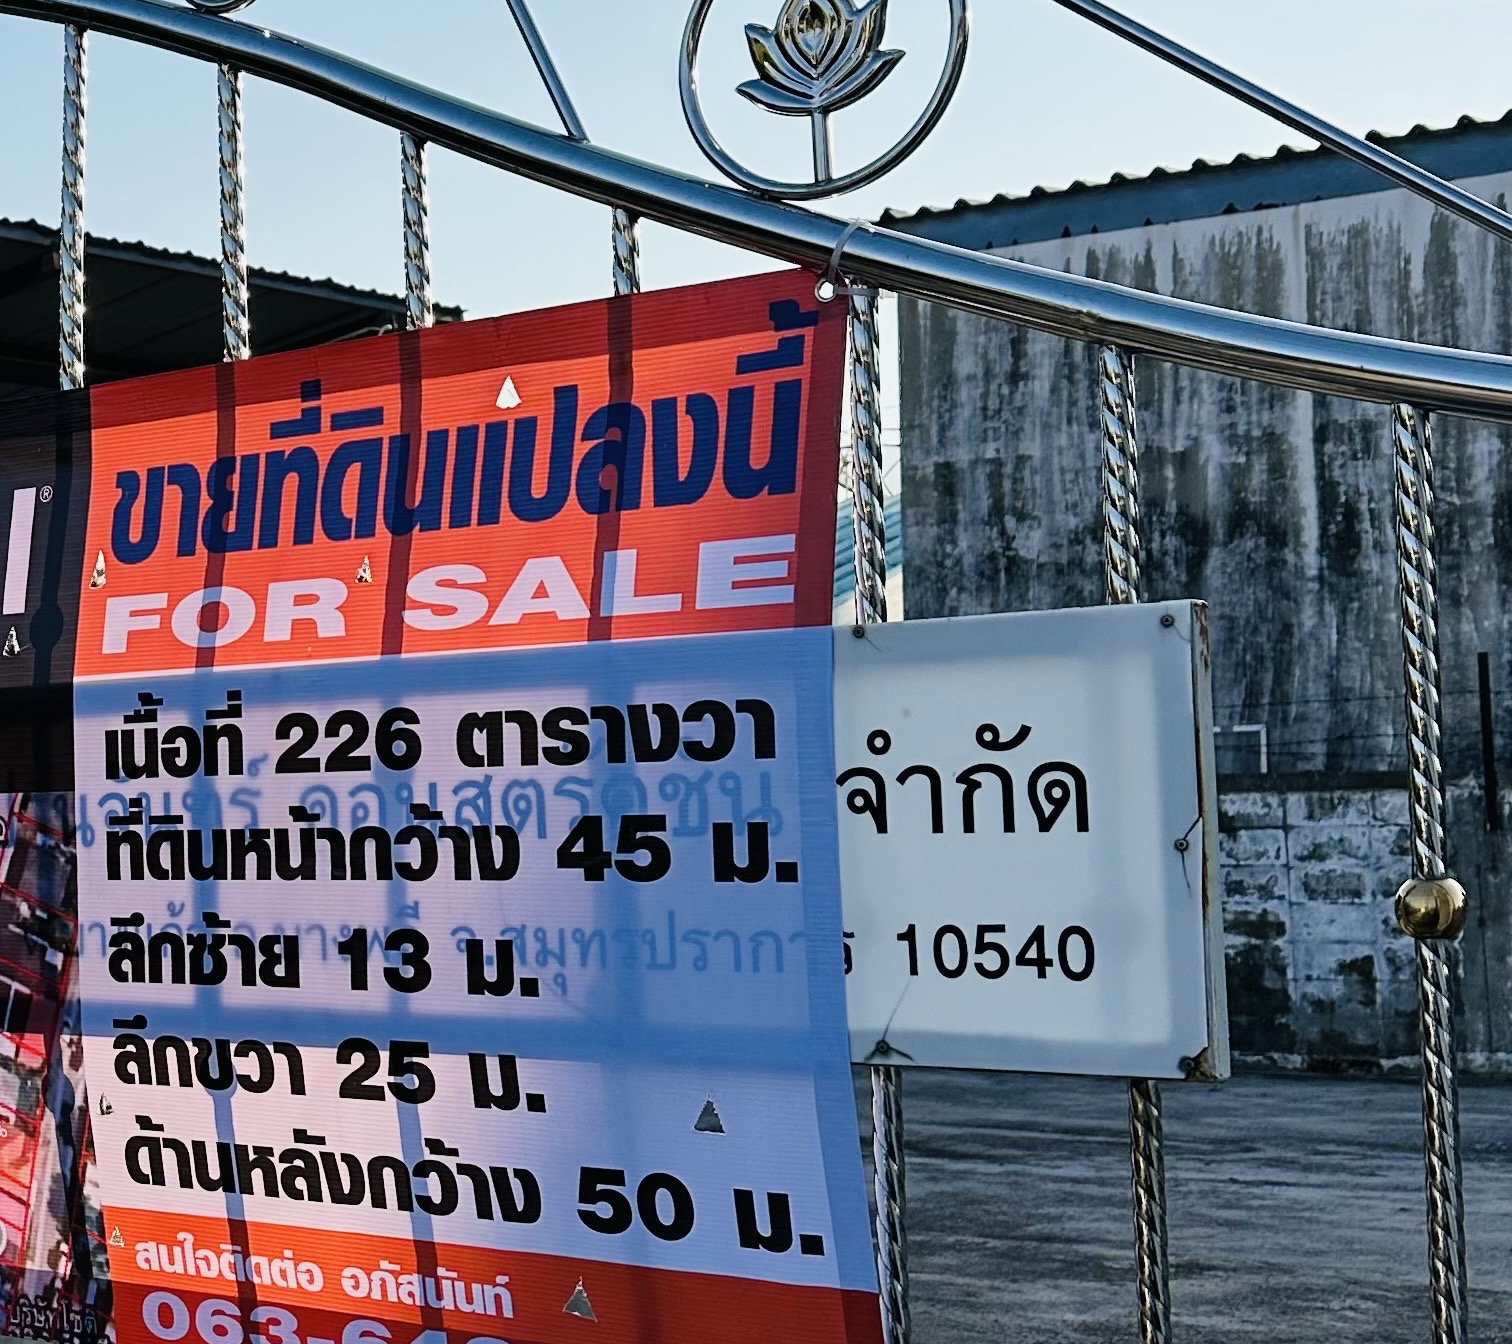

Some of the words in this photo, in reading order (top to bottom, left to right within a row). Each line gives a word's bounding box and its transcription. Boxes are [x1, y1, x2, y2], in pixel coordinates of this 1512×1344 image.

[109, 299, 820, 566] ขายที่ดินแปลงนี้
[101, 578, 349, 655] FOR
[402, 535, 795, 631] SALE
[105, 689, 243, 780] เนื้อที่
[275, 706, 422, 774] 226
[456, 699, 777, 768] ตารางวา
[835, 723, 1090, 834] จำกัด
[106, 798, 521, 882] ที่ดินหน้ากว้าง
[556, 814, 672, 883] 45
[712, 821, 799, 883] ม.
[108, 912, 300, 988] ลึกซ้าย
[338, 927, 432, 994] 13
[465, 938, 540, 998] ม.
[897, 924, 1095, 982] 10540
[112, 1014, 306, 1096] ลึกขวา
[338, 1037, 437, 1106] 25
[469, 1051, 547, 1114] ม.
[124, 1114, 543, 1225] ด้านหลังกว้าง
[576, 1166, 695, 1242] 50
[734, 1188, 826, 1256] ม.
[134, 1232, 324, 1293] สนใจติดต่อ
[340, 1258, 515, 1319] อภัสนันท์
